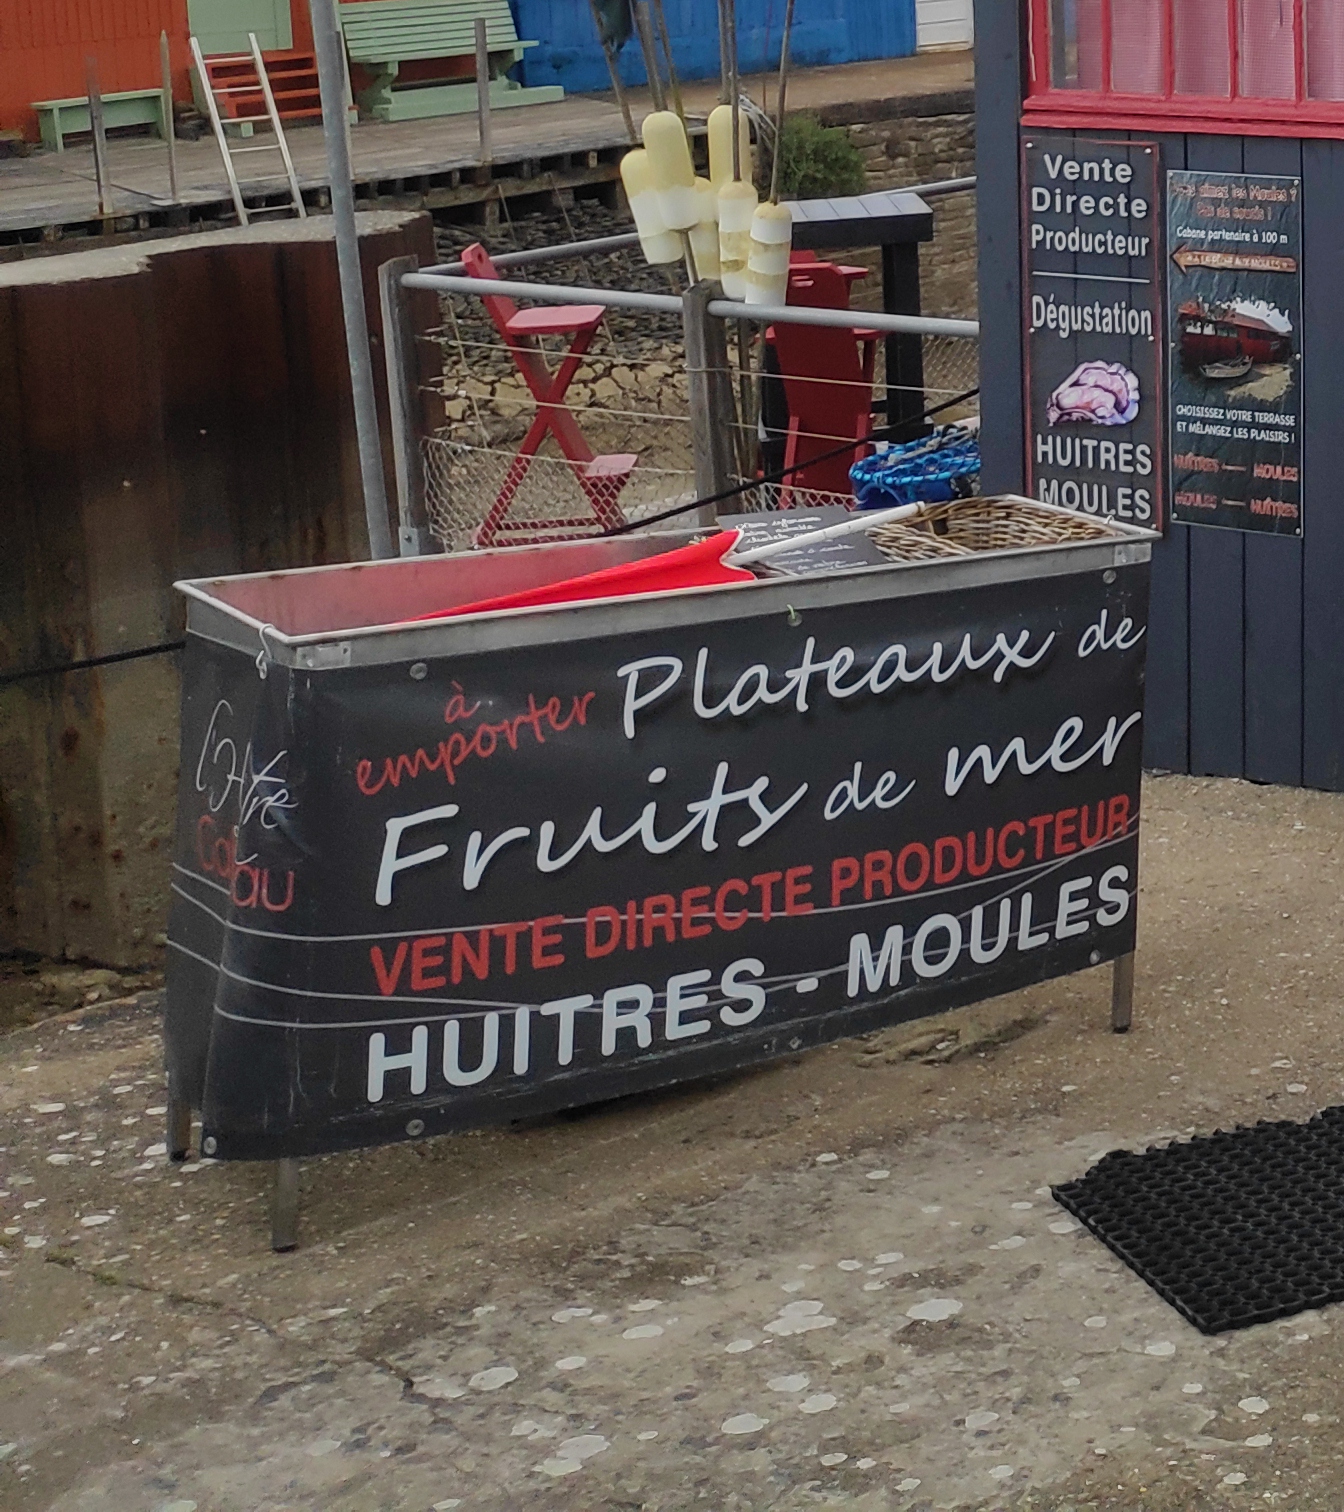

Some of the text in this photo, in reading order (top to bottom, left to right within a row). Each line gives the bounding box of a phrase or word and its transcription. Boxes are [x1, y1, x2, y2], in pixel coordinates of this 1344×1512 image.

[1043, 153, 1134, 184] Vente
[1031, 186, 1148, 219] Directe
[1031, 224, 1150, 257] Producteur
[1177, 226, 1288, 243] Cabane partenaire à 100 m
[1031, 293, 1153, 339] Dégustation
[1176, 405, 1295, 426] CHOISISSEZ VOTRE TERRASSE
[1177, 421, 1187, 432] ET
[1189, 422, 1231, 437] MÉLANGEZ
[1233, 427, 1248, 439] LES
[1250, 429, 1289, 443] PLAISIRS
[1036, 434, 1153, 476] HUITRES
[1039, 478, 1152, 520] MOULES
[356, 690, 597, 799] emporter
[617, 629, 1055, 739] Plateaux
[1078, 607, 1146, 655] de
[444, 683, 478, 724] à
[373, 764, 810, 909] Fruits
[823, 760, 916, 823] de
[944, 707, 1143, 799] mer
[370, 794, 1131, 997] VENTE DIRECTE PRODUCTEUR
[366, 956, 768, 1104] HUITRES
[846, 865, 1131, 998] MOULES
